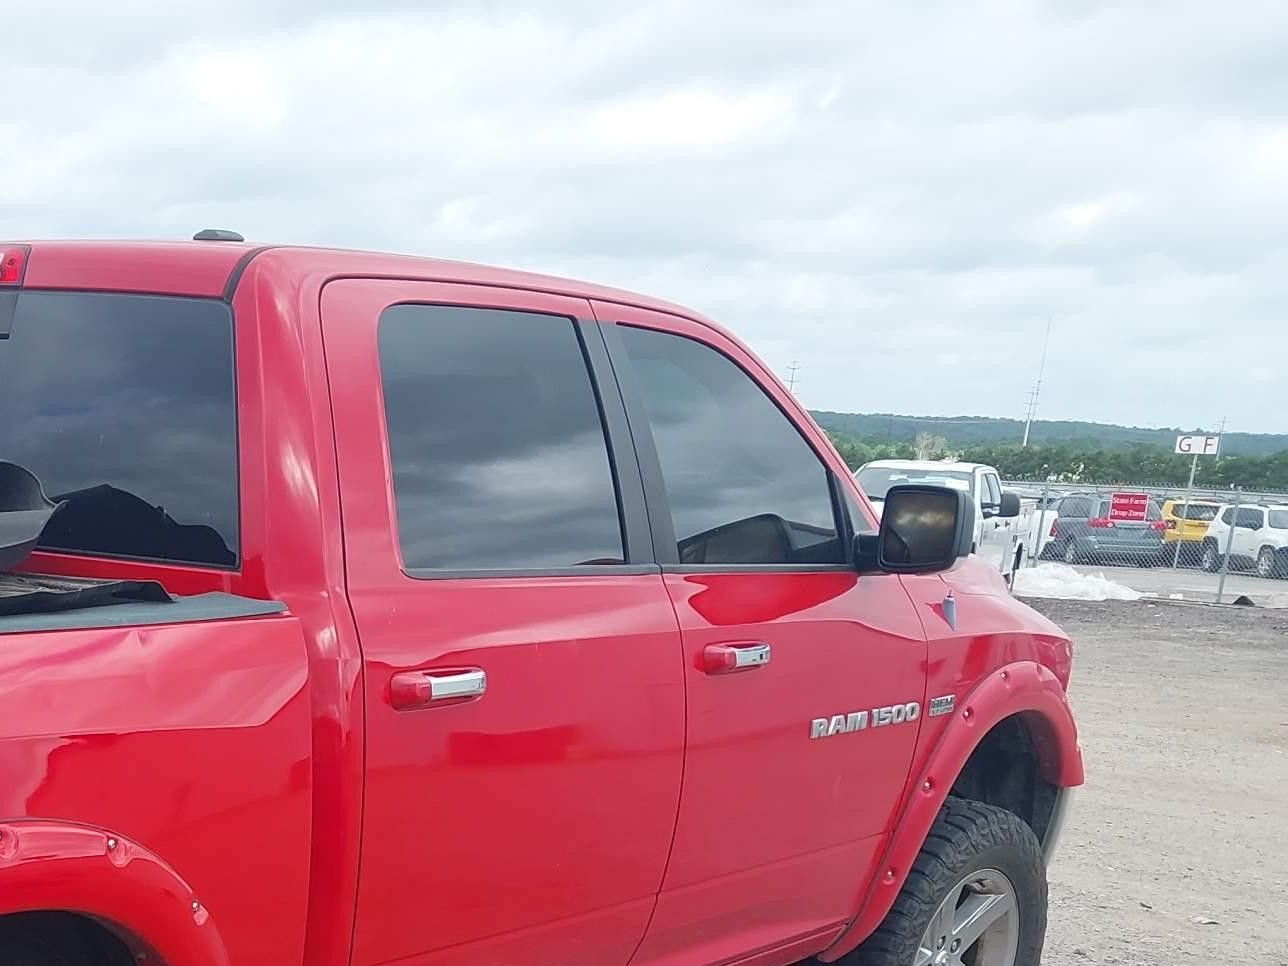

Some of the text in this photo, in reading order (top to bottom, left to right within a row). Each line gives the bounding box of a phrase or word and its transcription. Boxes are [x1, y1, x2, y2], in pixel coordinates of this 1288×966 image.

[1178, 436, 1215, 453] G F
[1112, 496, 1147, 505] State Farm
[1111, 509, 1145, 518] Drop Zone
[809, 702, 921, 740] RAM 1500
